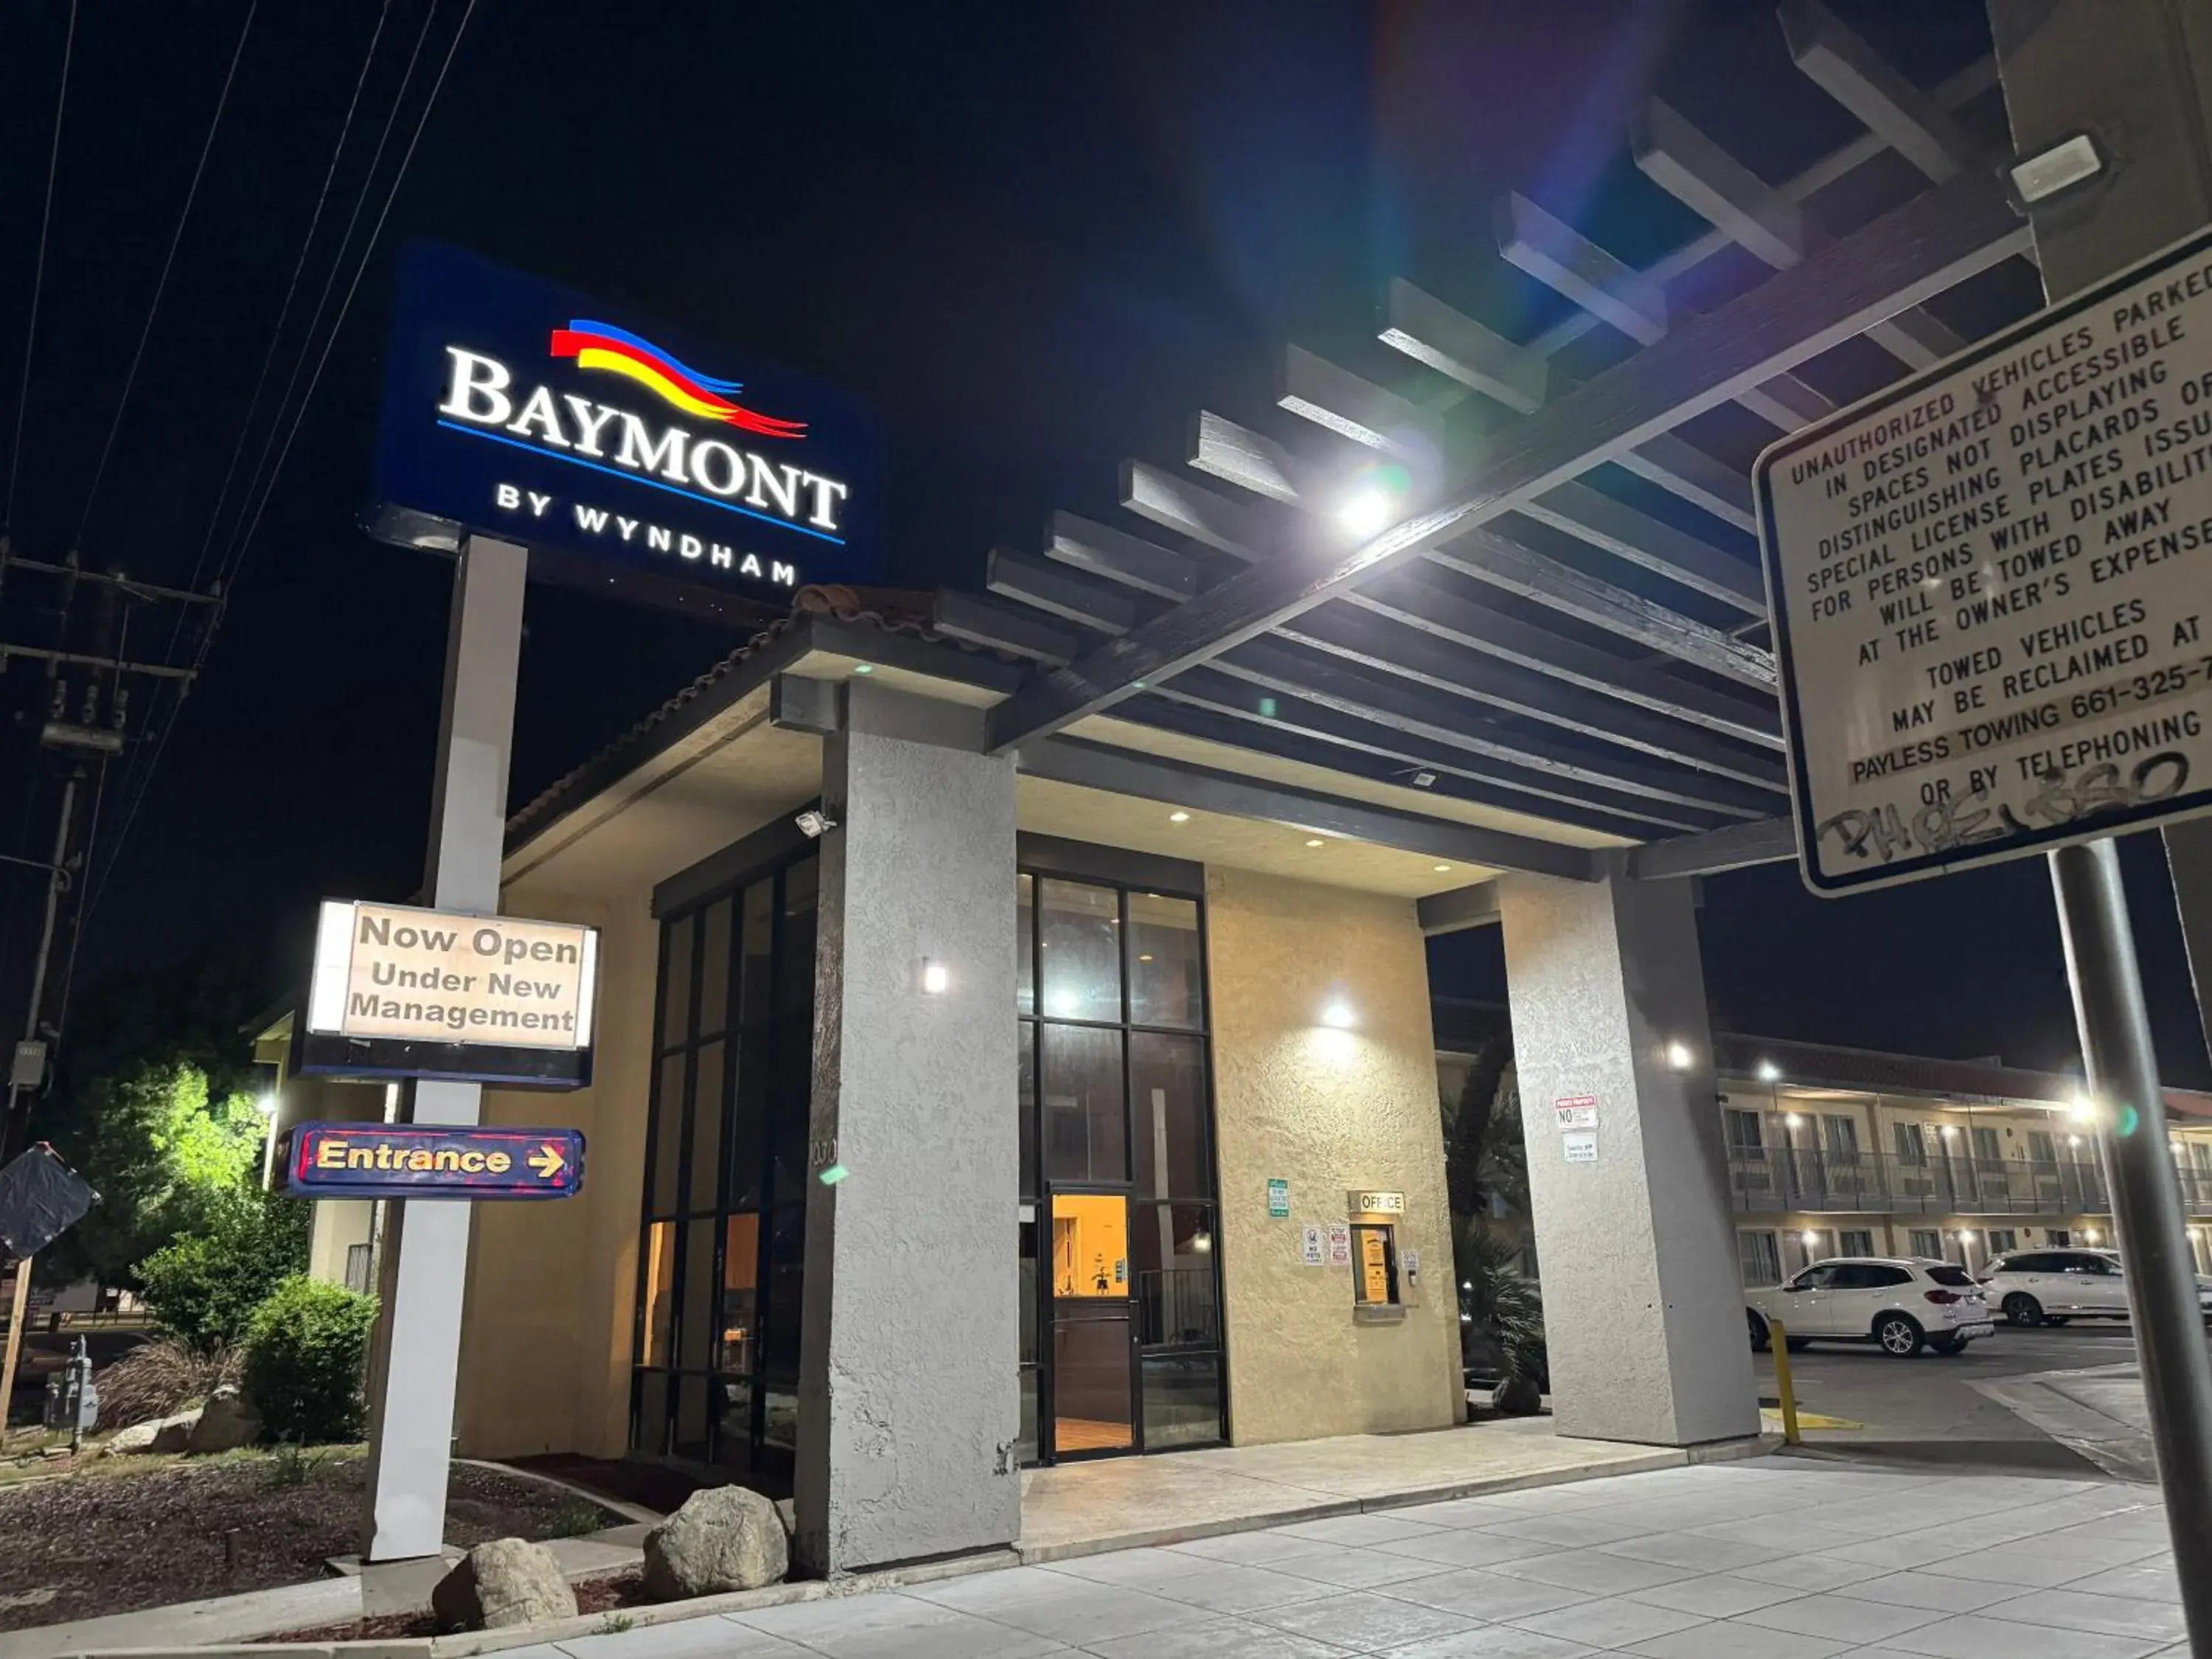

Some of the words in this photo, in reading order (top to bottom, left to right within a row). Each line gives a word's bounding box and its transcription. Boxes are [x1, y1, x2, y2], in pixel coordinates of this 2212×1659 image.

[440, 346, 847, 529] BAYMONT
[1792, 393, 1954, 484] UNAUTHORIZED
[1972, 327, 2093, 399] VEHICLES
[1826, 473, 1847, 499] IN
[1863, 404, 2001, 481] DESIGNATED
[2023, 315, 2185, 411] ACCESSIBLE
[1848, 467, 1929, 518] SPACES
[1947, 437, 1991, 476] NOT
[2010, 360, 2166, 448] DISPLAYING
[1807, 543, 1896, 594] SPECIAL
[1911, 494, 2011, 553] LICENSE
[2029, 449, 2123, 505] PLATES
[1819, 467, 2000, 560] DISTINGUISHING
[2020, 398, 2159, 476] PLACARDS
[496, 484, 552, 517] BY
[575, 504, 796, 587] WYNDHAM
[1812, 590, 1851, 622] FOR
[1868, 543, 1973, 601] PERSONS
[1990, 511, 2050, 552] WITH
[1879, 591, 1933, 626] WILL
[1950, 571, 1981, 601] BE
[1997, 534, 2081, 582] TOWED
[2105, 497, 2171, 546] AWAY
[1859, 639, 1879, 667] AT
[1895, 618, 1939, 653] THE
[1957, 572, 2070, 630] OWNER'S
[1927, 647, 2002, 689] TOWED
[2020, 599, 2146, 658] VEHICLES
[1892, 700, 1935, 733] MAY
[1954, 685, 1986, 714] BE
[2003, 634, 2149, 699] RECLAIMED
[2173, 615, 2199, 647] AT
[1853, 735, 1950, 784] PAYLESS
[1958, 703, 2060, 751] TOWING
[1921, 779, 1950, 806] OR
[1969, 765, 1997, 793] BY
[2016, 711, 2201, 780] TELEPHONING
[359, 916, 457, 952] Now
[473, 929, 578, 965] Open
[372, 961, 477, 993] Under
[487, 972, 561, 1000] New
[349, 992, 574, 1032] Management
[316, 1140, 512, 1174] Entrance
